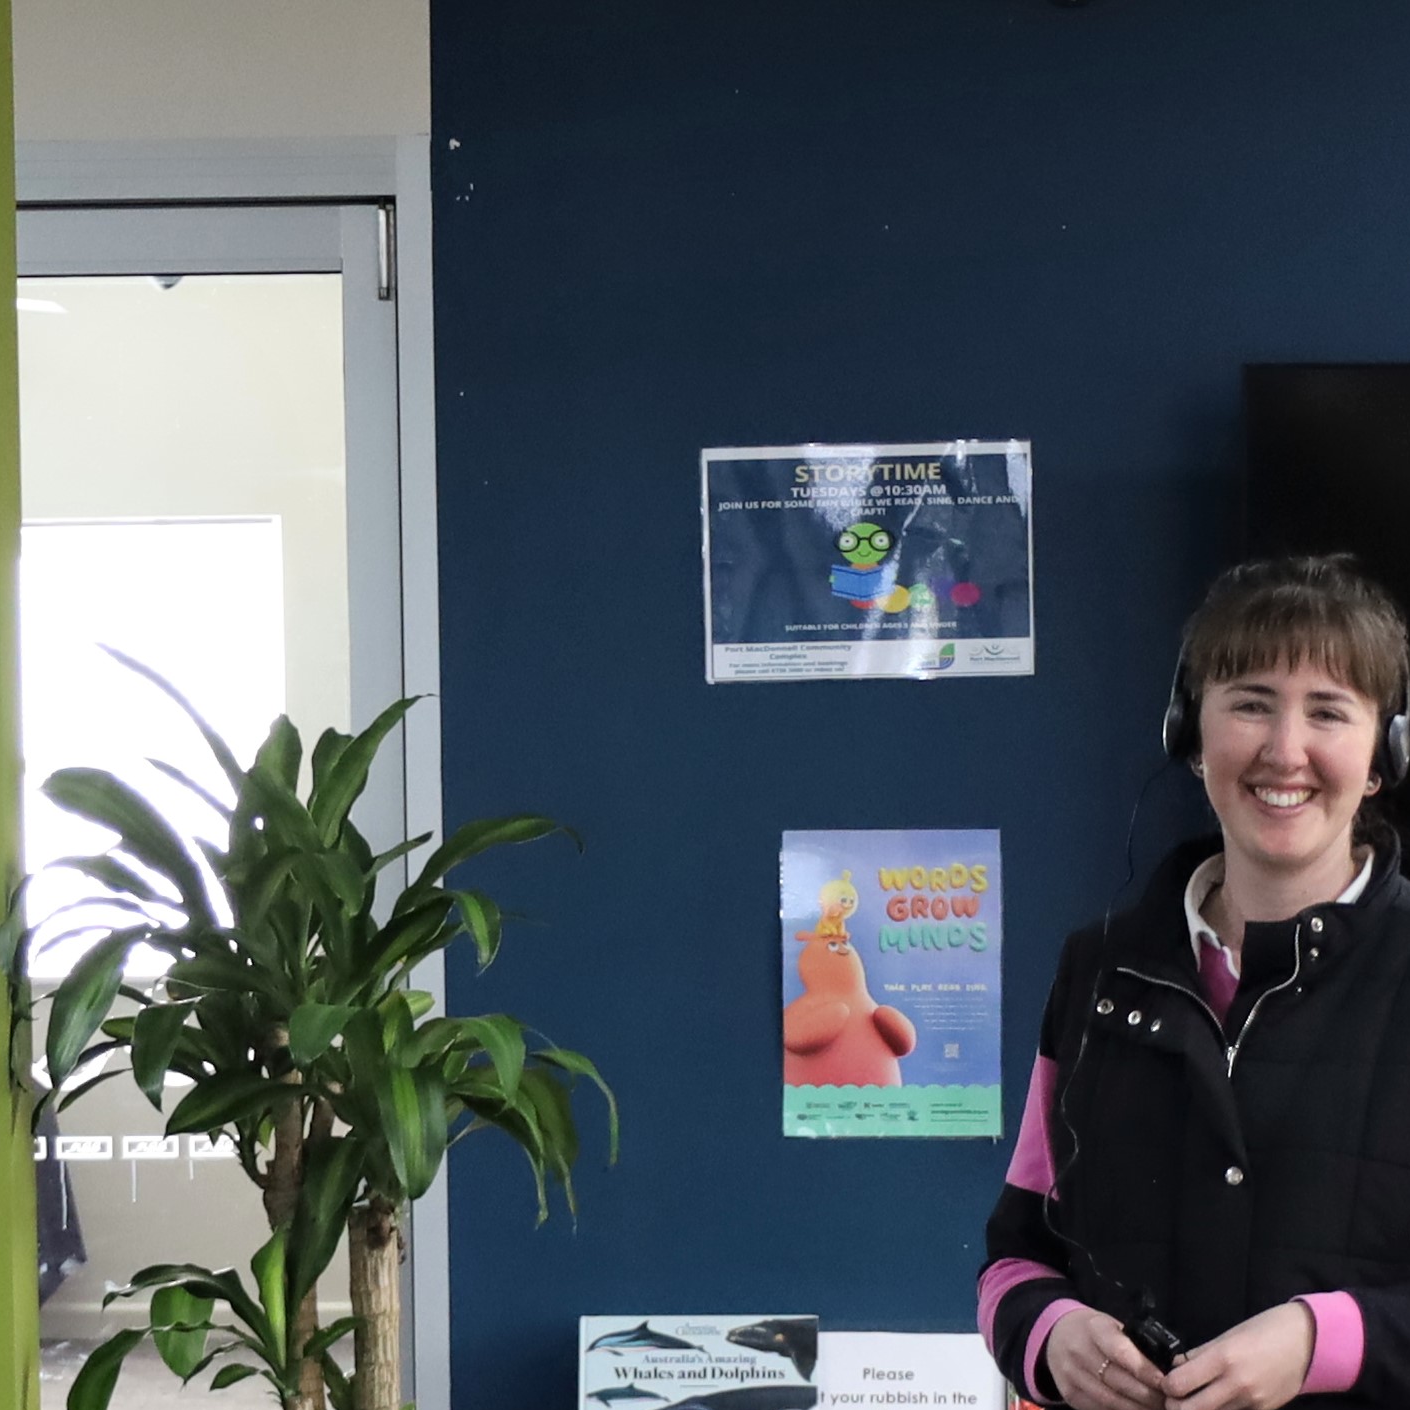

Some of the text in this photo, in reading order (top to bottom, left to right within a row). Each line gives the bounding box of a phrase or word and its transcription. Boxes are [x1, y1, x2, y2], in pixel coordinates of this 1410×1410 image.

[795, 462, 941, 483] STORYTIME
[791, 484, 946, 498] TUESDAYS @10:30AM
[718, 501, 742, 511] JOIN
[745, 501, 759, 509] US
[761, 501, 782, 509] FOR
[784, 500, 814, 508] SOME
[876, 498, 892, 506] WE
[958, 496, 993, 504] DANCE
[996, 495, 1019, 503] AND
[879, 863, 988, 893] WORDS
[886, 894, 980, 922] GROW
[879, 921, 988, 954] MINDS
[642, 1354, 757, 1365] Australia's Amazing
[614, 1366, 785, 1383] Whales and Dolphins
[862, 1367, 915, 1381] Please
[830, 1393, 865, 1406] your
[870, 1391, 928, 1404] rubbish
[933, 1391, 947, 1404] in
[952, 1391, 978, 1405] the
